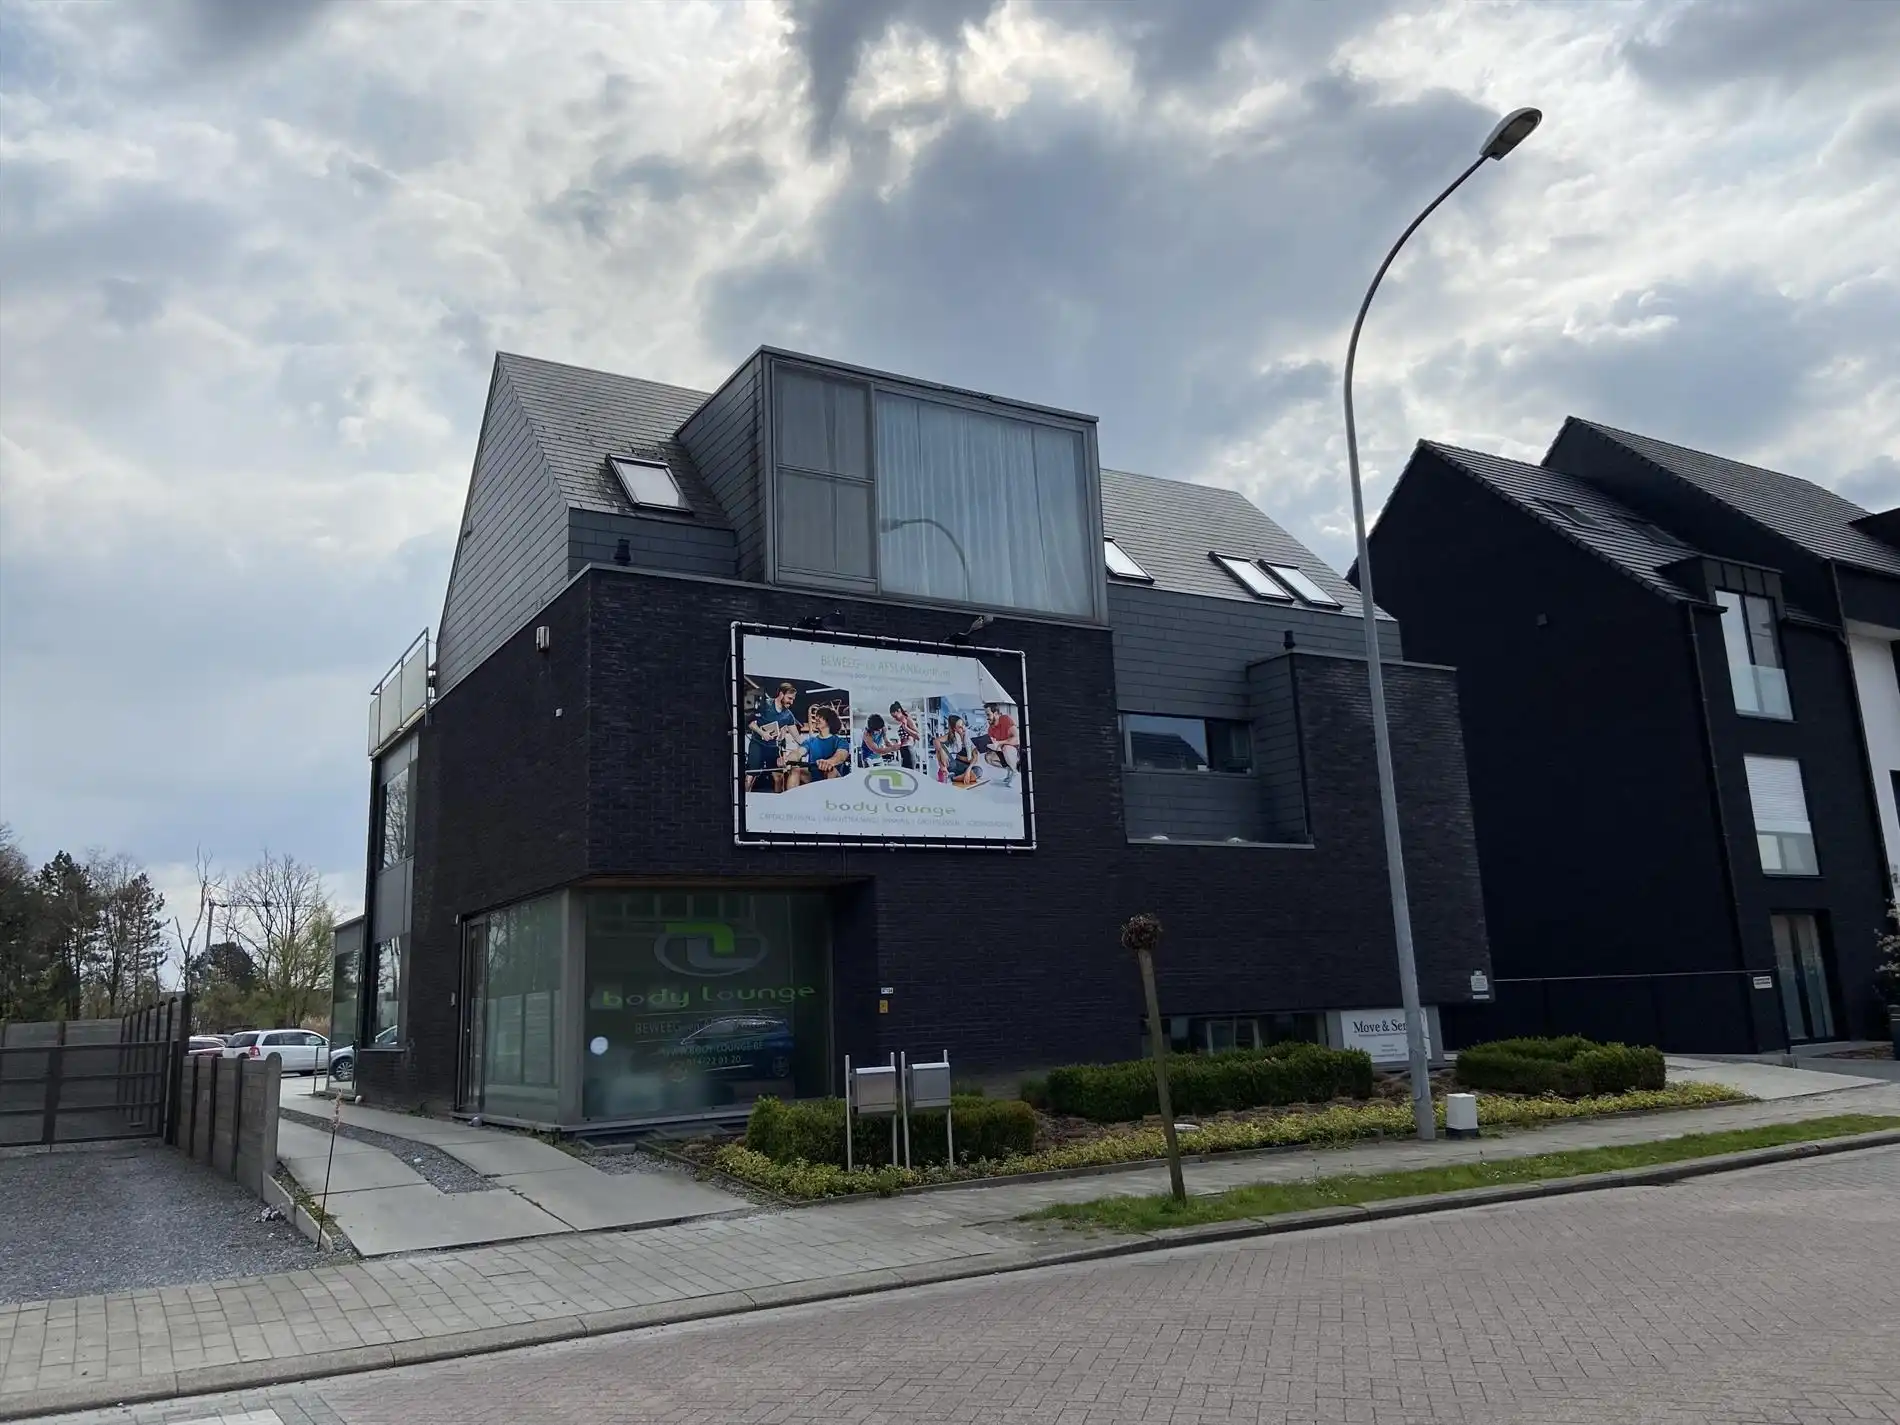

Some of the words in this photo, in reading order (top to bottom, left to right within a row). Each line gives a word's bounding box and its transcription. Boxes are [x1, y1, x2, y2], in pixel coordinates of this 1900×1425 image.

[826, 800, 878, 814] body
[885, 802, 956, 817] lounge
[602, 988, 690, 1008] body
[702, 985, 816, 1004] lounge
[1353, 1020, 1380, 1033] Move
[1382, 1020, 1390, 1032] &
